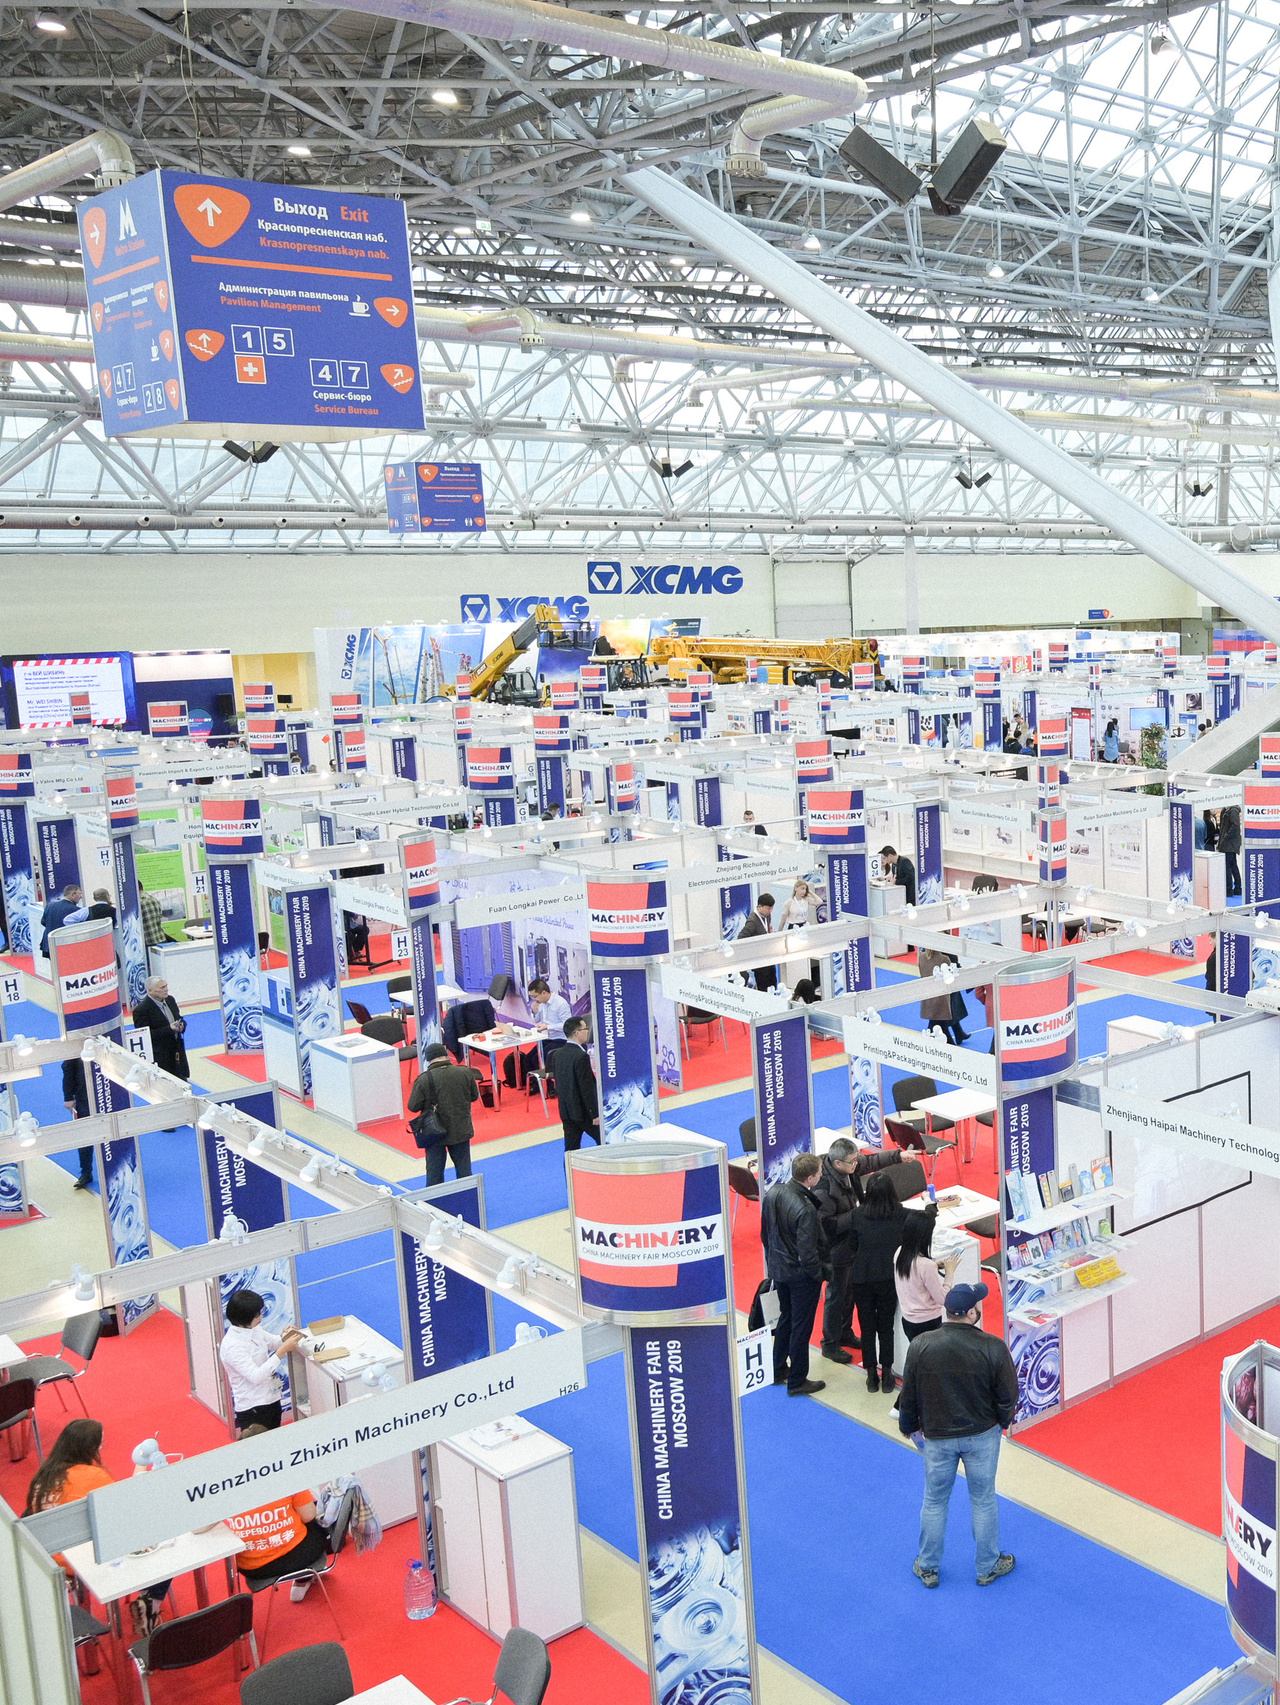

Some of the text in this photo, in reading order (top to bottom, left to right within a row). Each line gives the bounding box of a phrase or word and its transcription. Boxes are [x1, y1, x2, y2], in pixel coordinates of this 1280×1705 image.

[274, 198, 328, 221] Выход
[341, 206, 369, 223] Exit
[258, 219, 387, 243] Краснопресненская наб.
[260, 237, 389, 260] Krasnopresnenskaya nab.
[219, 282, 349, 302] Администрация павильона
[221, 296, 321, 312] Pavilion Management
[242, 331, 285, 350] 1 5
[318, 366, 360, 382] 4 7
[313, 390, 372, 402] Сервис-бюро
[315, 404, 379, 415] Service Bureau
[625, 566, 743, 594] XCMG
[344, 634, 356, 668] XCMG
[204, 821, 259, 831] MACHINERY
[810, 812, 862, 821] MACHINERY
[688, 865, 799, 887] Electromechanical Technology Co.,Ltd
[716, 860, 770, 873] Zhejiang Richuang
[196, 885, 206, 893] 21
[488, 897, 561, 913] Fuan Longkai Power
[591, 912, 665, 924] MACHINERY
[293, 915, 304, 955] MACHINERY
[303, 913, 312, 945] MOSCOW
[397, 929, 408, 947] H
[5, 979, 18, 992] H
[7, 993, 20, 1001] 18
[763, 1032, 771, 1054] FAIR
[893, 1037, 952, 1062] Wenzhou Lisheng
[774, 1030, 784, 1098] MOSCOW 2019
[764, 1057, 774, 1113] MACHINERY
[1106, 1105, 1149, 1127] Zhenjiang
[1150, 1117, 1178, 1133] Haipai
[1180, 1125, 1226, 1148] Machinery
[581, 1223, 717, 1248] MACHINERY
[582, 1243, 719, 1261] CHINA MACHINERY FAIR MOSCOW 2019
[746, 1343, 763, 1372] H
[745, 1369, 765, 1388] 29
[667, 1340, 688, 1448] MOSCOW 2019
[185, 1376, 580, 1503] Wenzhou Zhixin Machinery Co.,Ltd H26
[646, 1340, 673, 1520] CHINA MACHINERY FAIR
